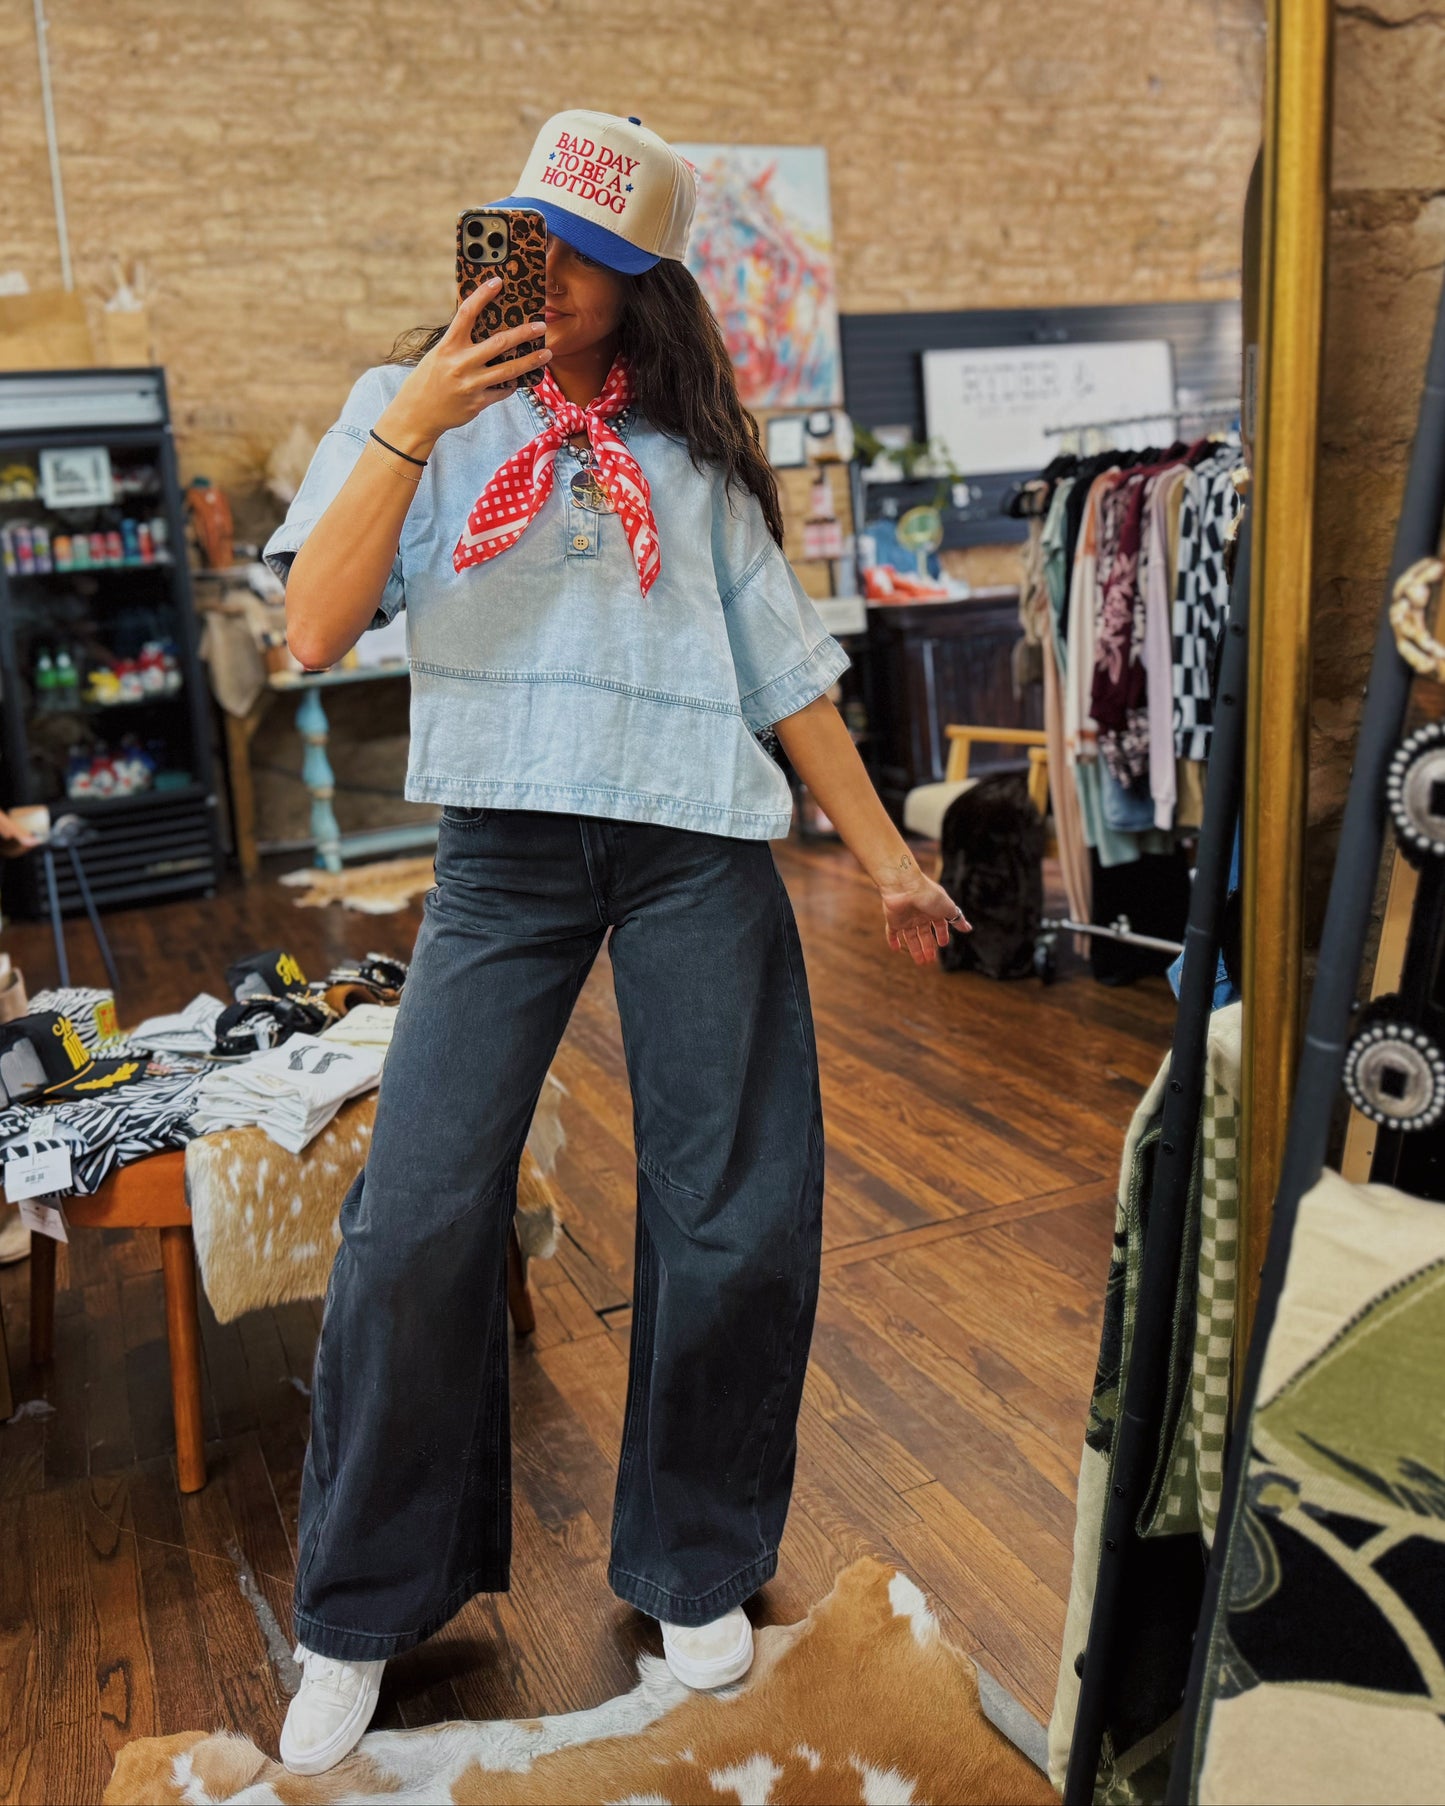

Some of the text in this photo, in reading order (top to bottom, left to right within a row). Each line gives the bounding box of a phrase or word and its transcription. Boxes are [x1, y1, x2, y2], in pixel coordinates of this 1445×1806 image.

[556, 132, 640, 177] BAD DAY
[557, 151, 622, 193] TO BE A
[541, 166, 626, 214] HOTDOG
